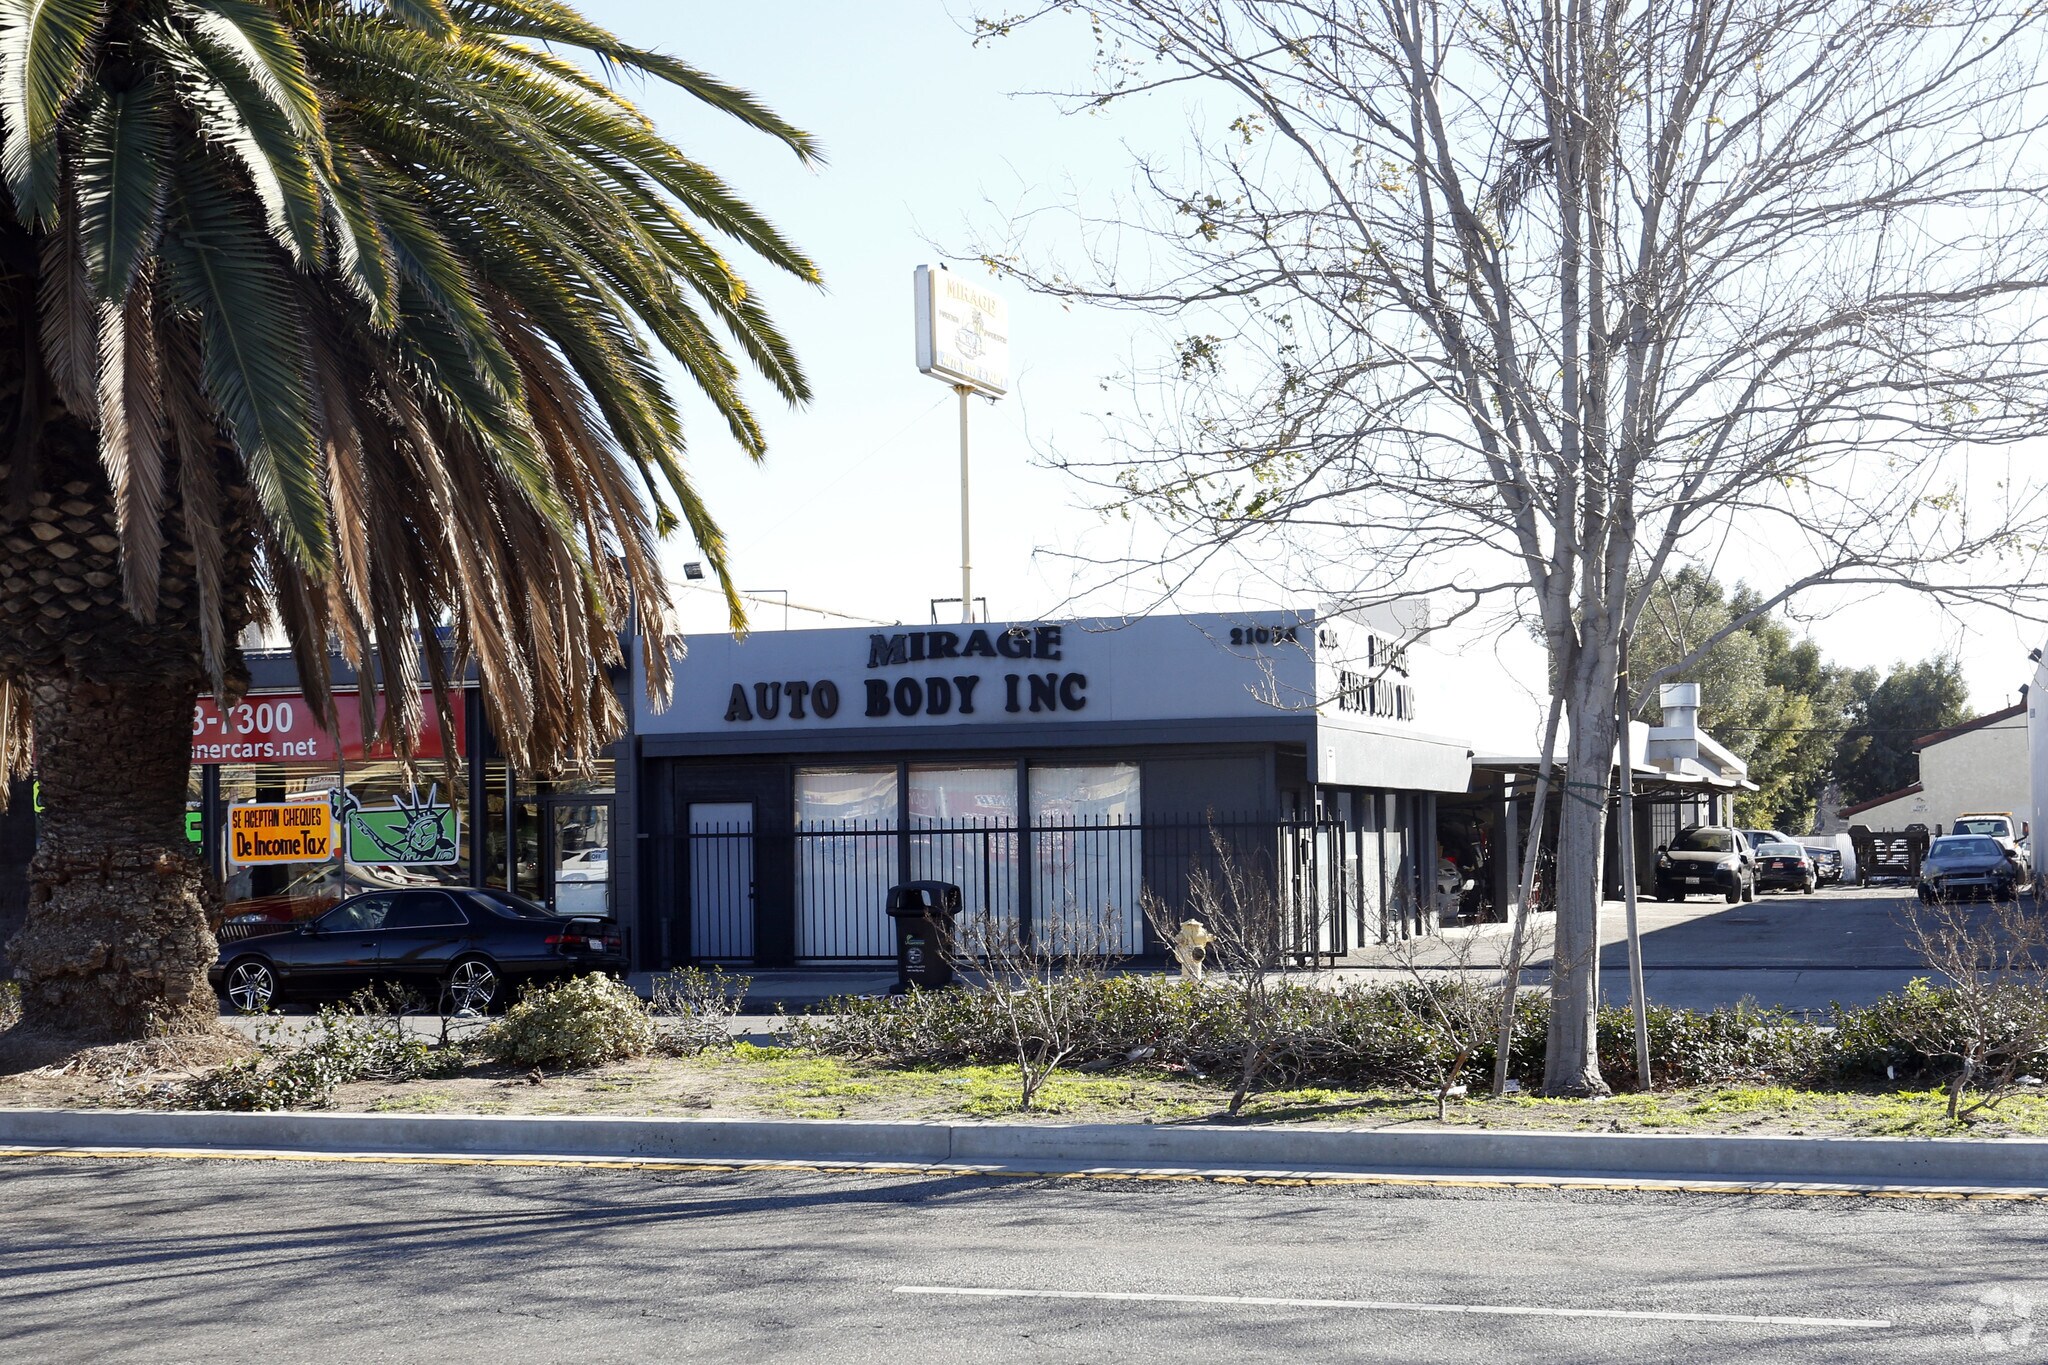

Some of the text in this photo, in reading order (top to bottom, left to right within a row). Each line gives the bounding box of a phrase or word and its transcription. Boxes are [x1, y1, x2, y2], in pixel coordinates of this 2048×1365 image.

[867, 626, 1062, 668] MIRAGE
[724, 672, 1087, 722] AUTO BODY INC
[191, 738, 316, 758] nercars.net
[232, 808, 321, 828] SE ACEPTAN CHEQUES
[236, 830, 327, 857] De Income Tax
